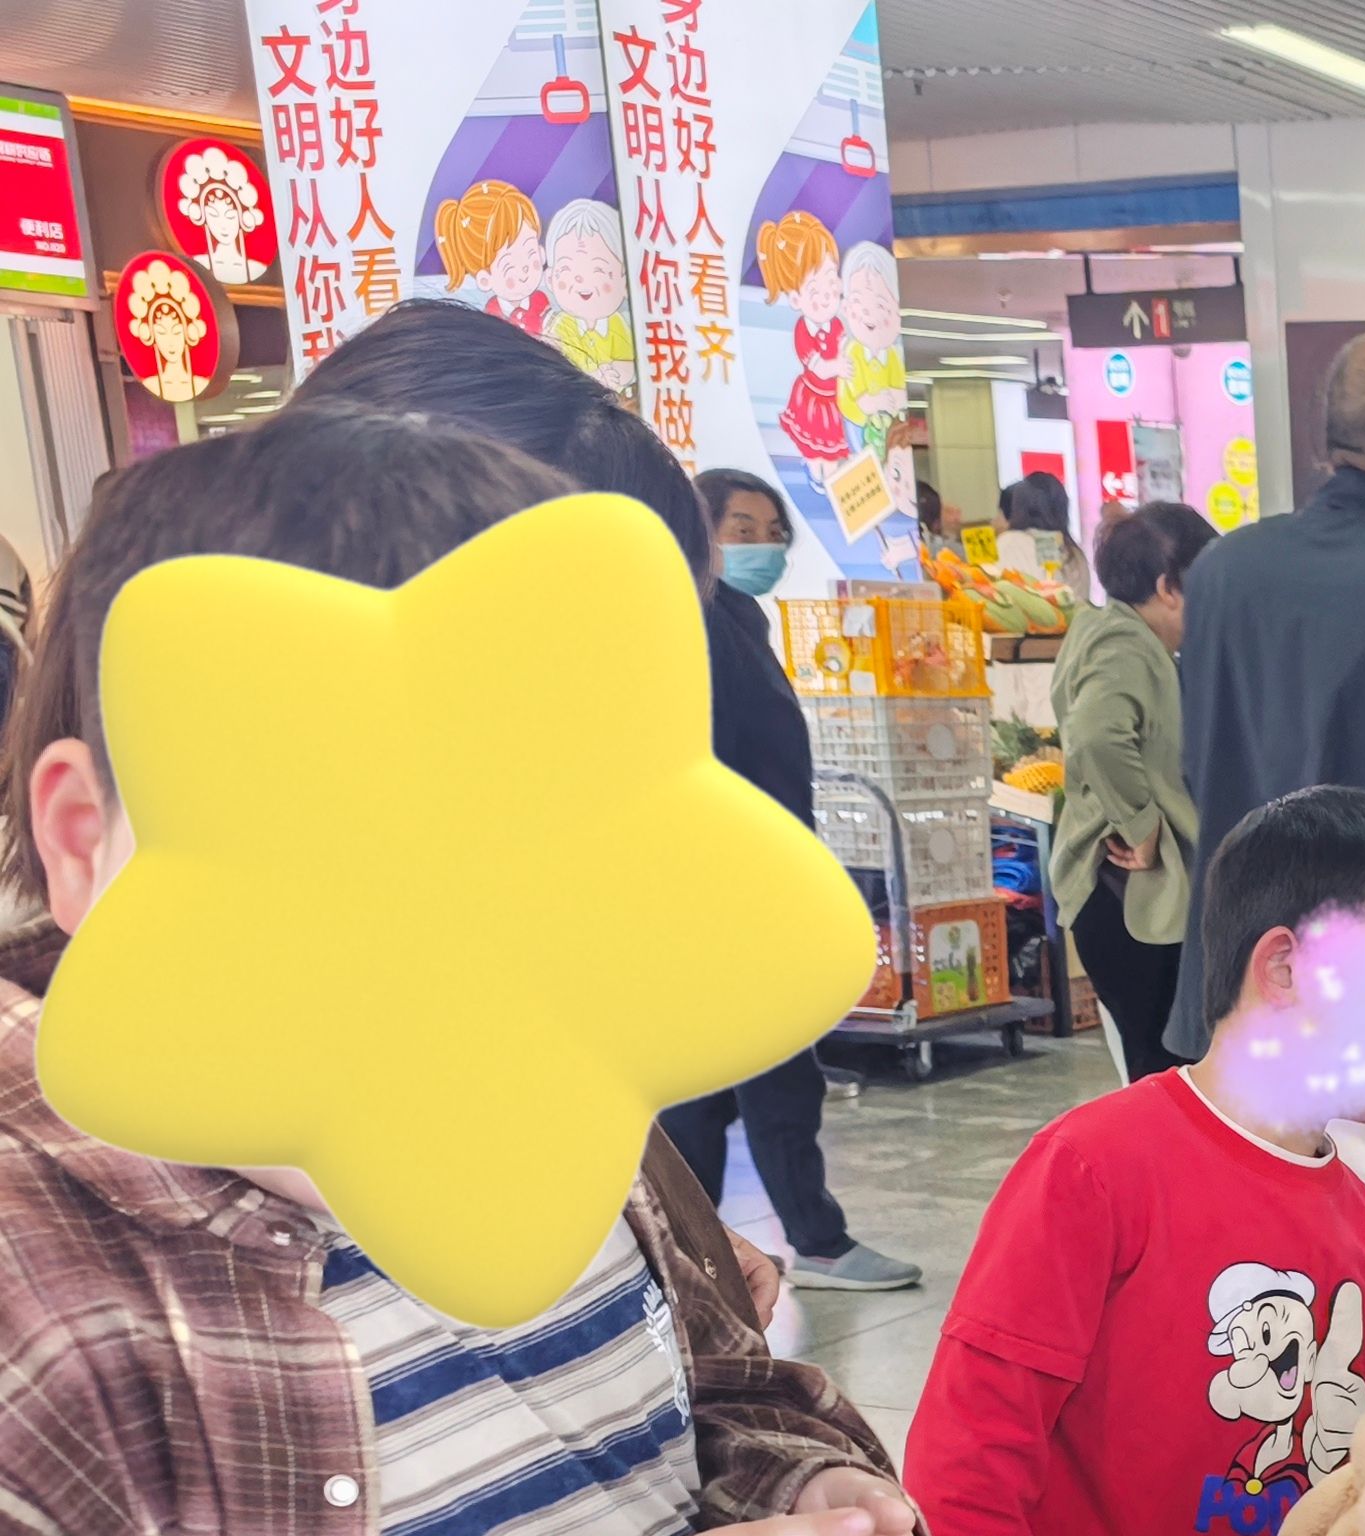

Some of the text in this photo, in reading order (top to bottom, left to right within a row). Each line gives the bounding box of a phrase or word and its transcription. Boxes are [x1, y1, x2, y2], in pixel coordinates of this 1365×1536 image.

[613, 25, 697, 475] 文明从你我做
[1155, 301, 1171, 338] 1
